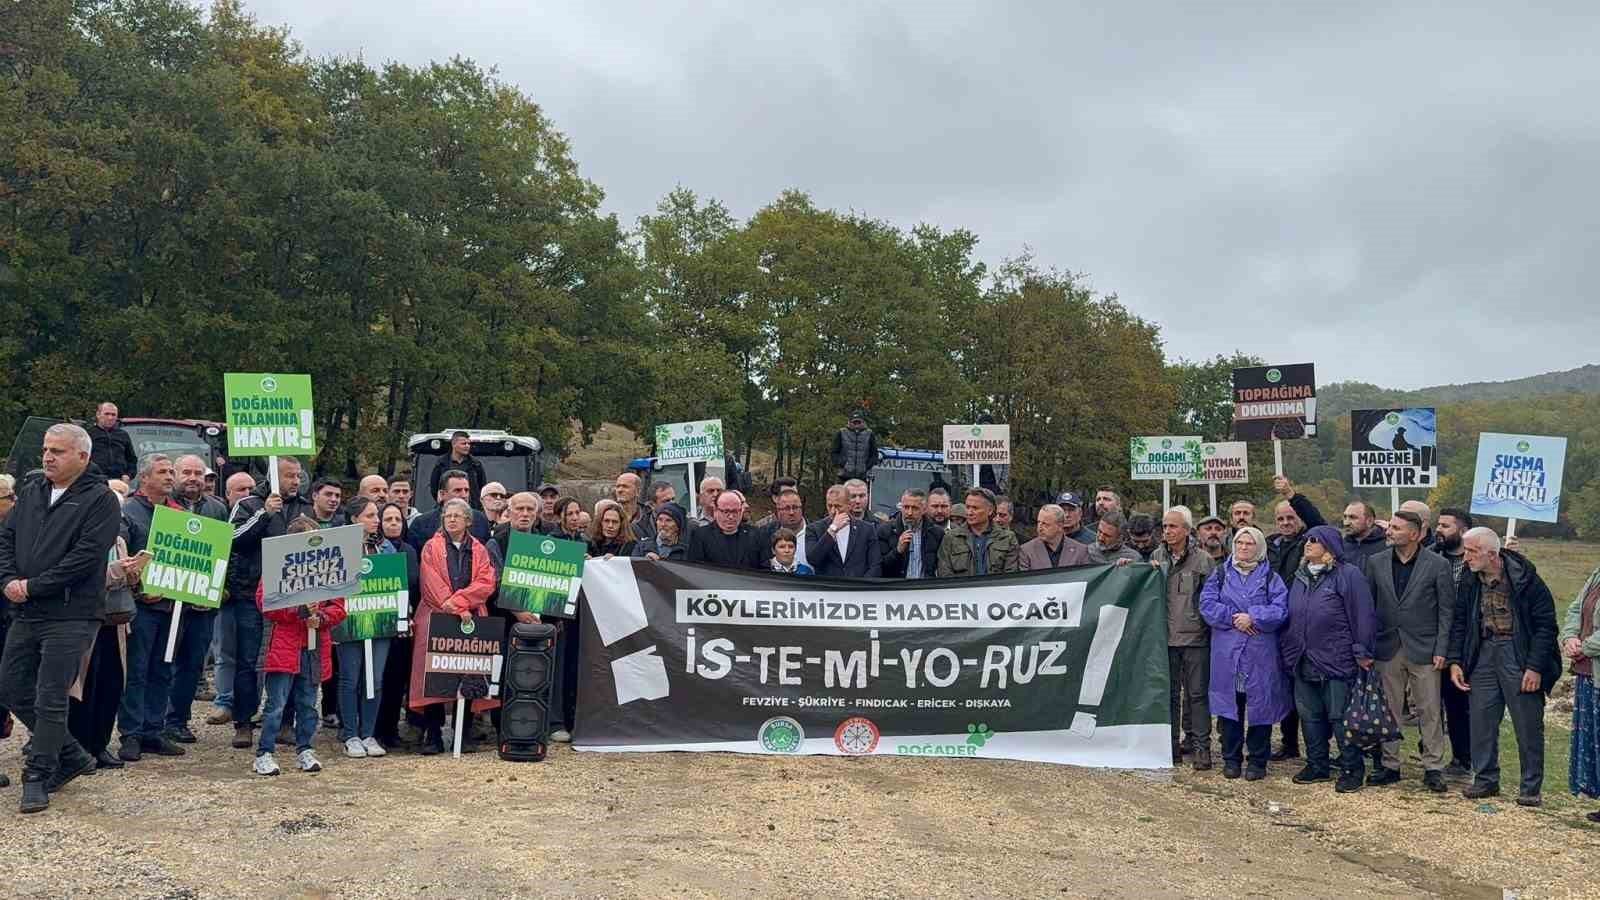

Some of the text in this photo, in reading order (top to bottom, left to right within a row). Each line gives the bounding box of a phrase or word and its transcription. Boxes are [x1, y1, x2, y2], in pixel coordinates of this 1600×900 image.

[1237, 384, 1313, 401] TOPRAĞIMA
[231, 394, 294, 411] DOĞANIN
[232, 412, 298, 426] TALANINA
[672, 435, 707, 449] DOĞAMI
[949, 440, 1005, 449] TOZ YUTMAK
[662, 445, 718, 459] KORUYORUM
[1147, 451, 1186, 462] DOĞAMI
[1357, 452, 1411, 465] MADENE
[1137, 463, 1197, 473] KORUYORUM
[1494, 454, 1544, 471] SUSMA
[1493, 470, 1541, 486] SUSUZ
[1487, 483, 1545, 504] KALMA!
[153, 531, 213, 557] DOĞANIN
[152, 547, 213, 574] TALANINA
[285, 546, 342, 567] SUSMA
[511, 554, 577, 576] ORMANIMA
[286, 558, 339, 580] SUSUZ
[280, 569, 346, 594] KALMA!
[686, 593, 1068, 621] KÖYLERİMİZDE MADEN OCAĞI
[431, 636, 501, 654] TOPRAĞIMA
[742, 696, 789, 707] FEVZİYE
[798, 696, 846, 708] ŞÜKRİYE
[855, 698, 908, 708] FINDICAK
[916, 698, 956, 708] ERİCEK
[965, 698, 1011, 709] DIŞKAYA
[896, 743, 977, 756] DOĞADER
